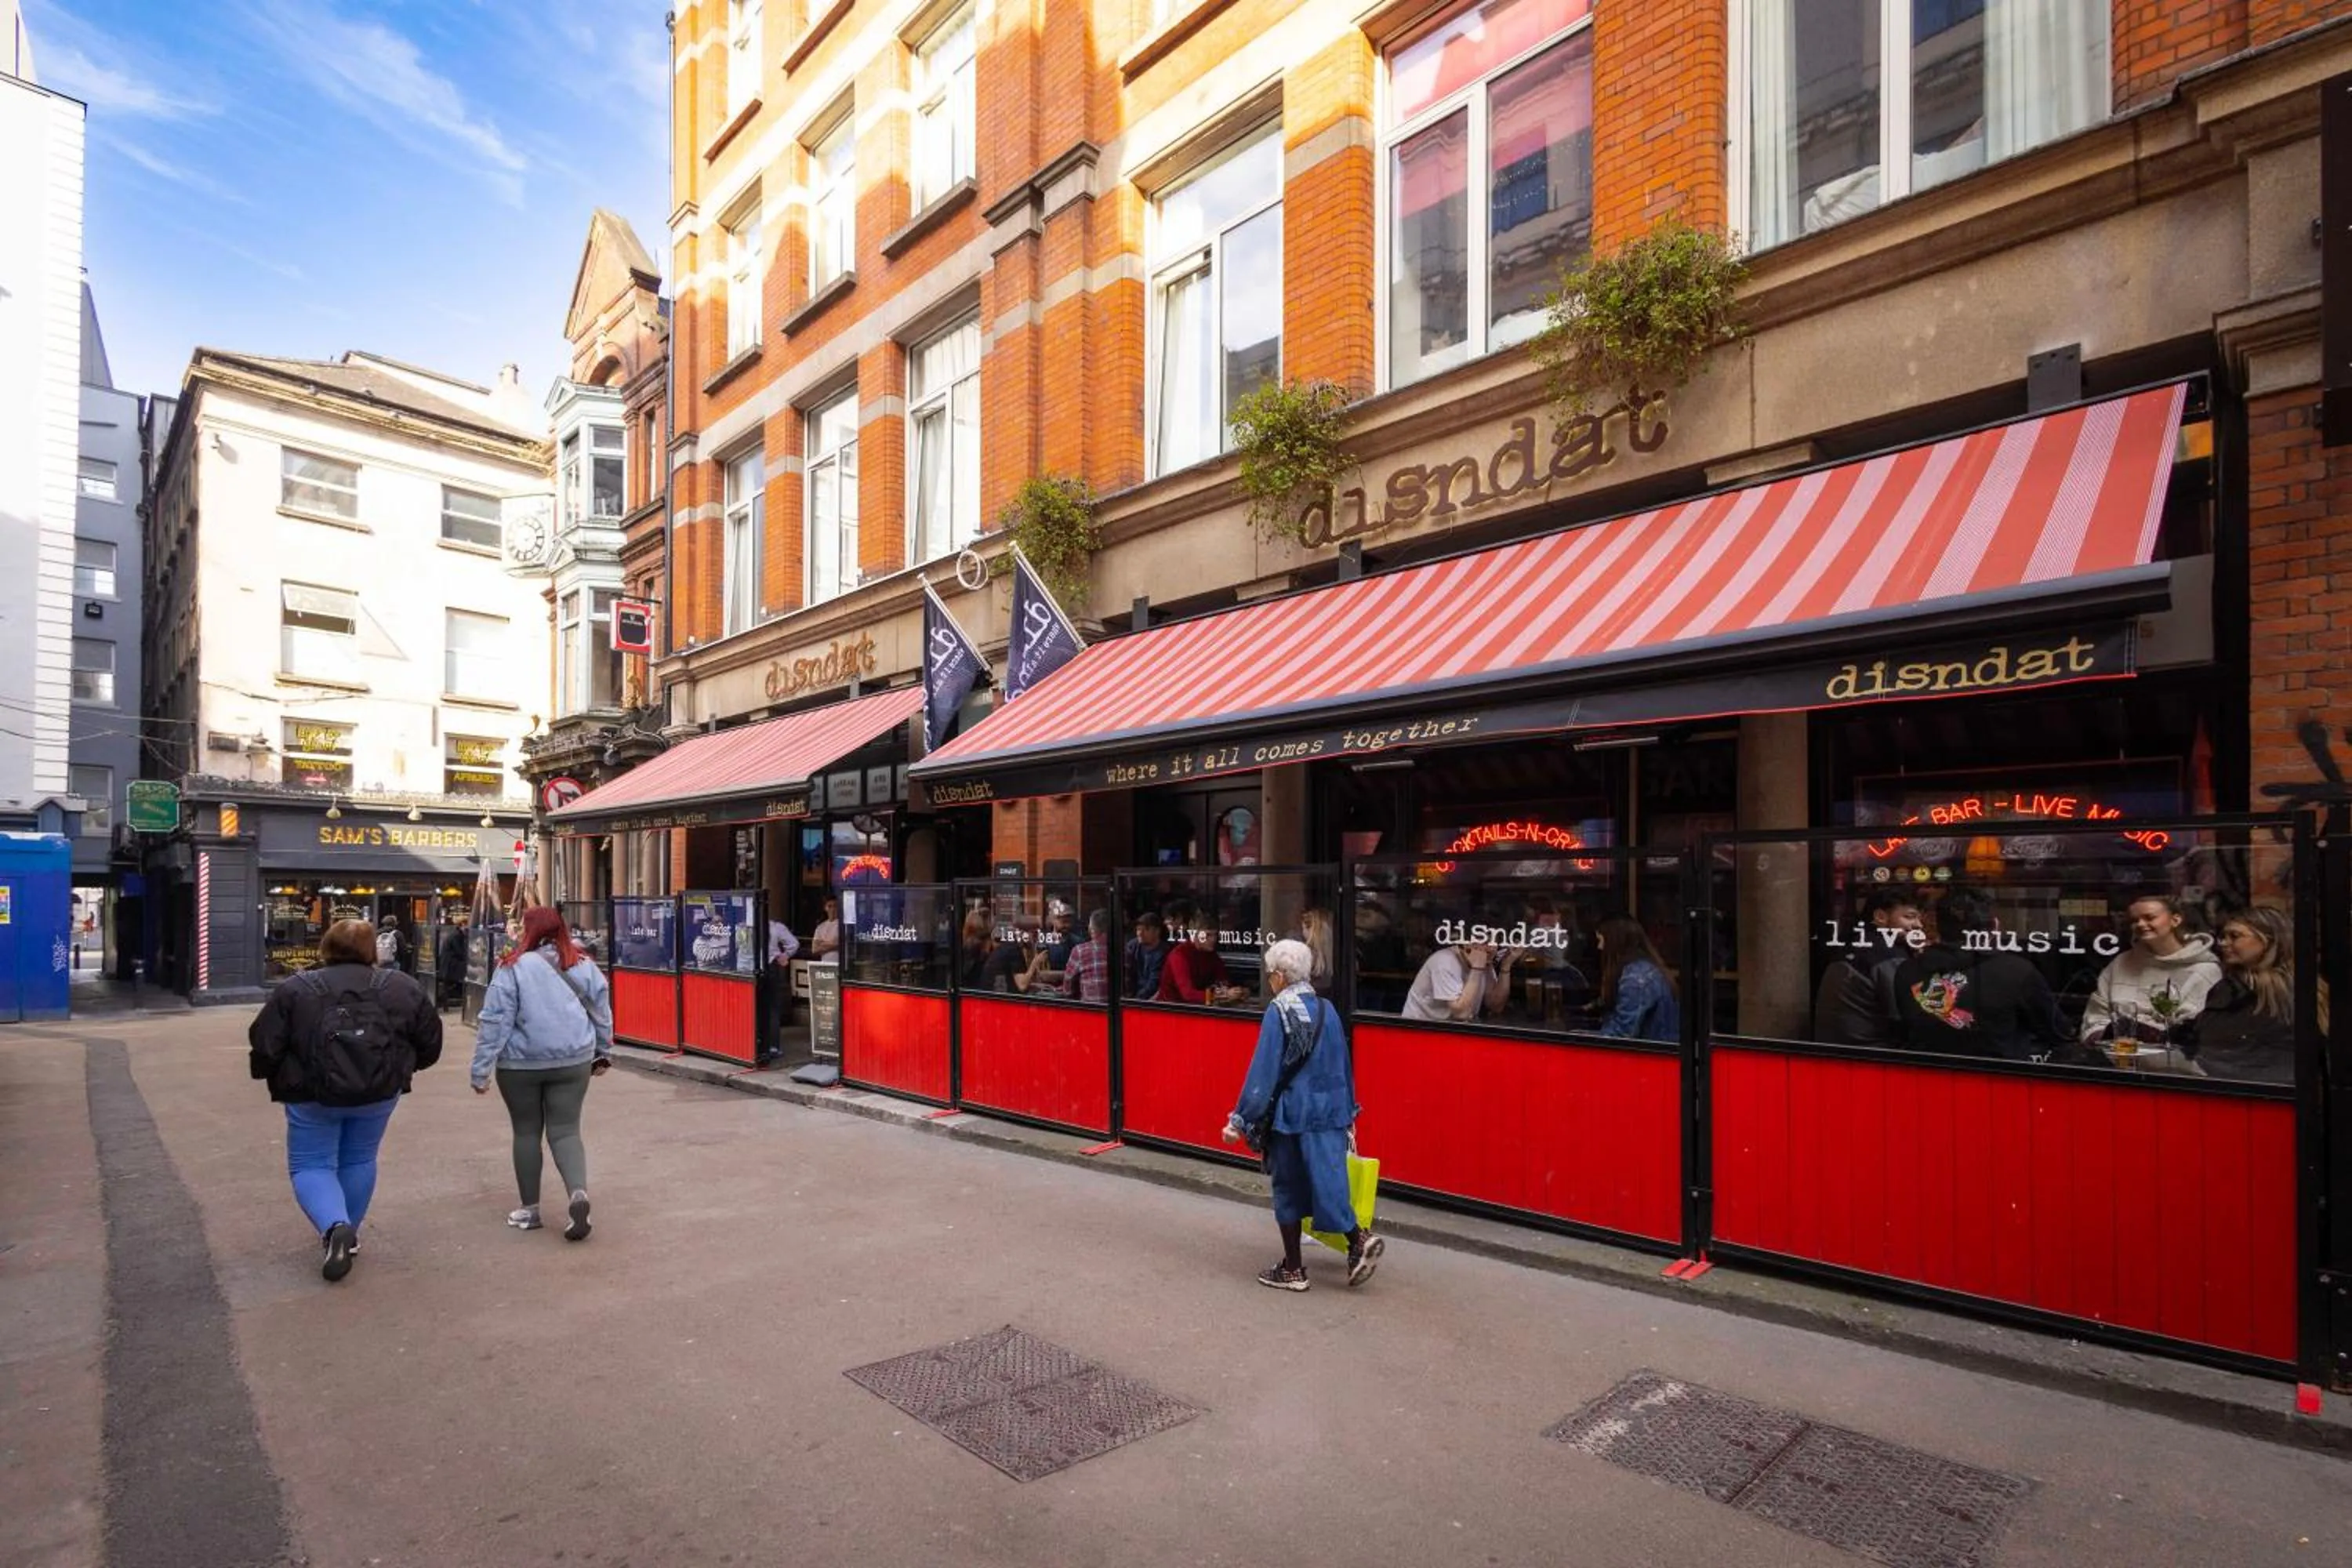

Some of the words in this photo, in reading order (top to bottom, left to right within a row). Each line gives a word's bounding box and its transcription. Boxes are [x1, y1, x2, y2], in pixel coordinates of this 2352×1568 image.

[1298, 384, 1669, 549] disndat
[765, 631, 877, 699] disndat
[1826, 636, 2094, 699] disndat
[1106, 764, 1157, 784] where
[1171, 755, 1192, 775] it
[1205, 747, 1240, 769] all
[1254, 739, 1324, 761] comes
[1341, 717, 1479, 749] together
[765, 798, 806, 816] disndat
[933, 780, 994, 804] disndat
[1931, 798, 1983, 825] BAR
[2014, 794, 2078, 818] LIVE
[318, 826, 383, 845] SAM'S
[389, 829, 478, 848] BARBERS
[871, 923, 916, 942] disndat
[1000, 927, 1029, 943] late
[1036, 929, 1062, 945] bar
[1167, 924, 1207, 943] live
[1218, 927, 1277, 946] music
[1435, 919, 1569, 949] disndat
[1825, 920, 1927, 948] live
[1961, 924, 2121, 956] music
